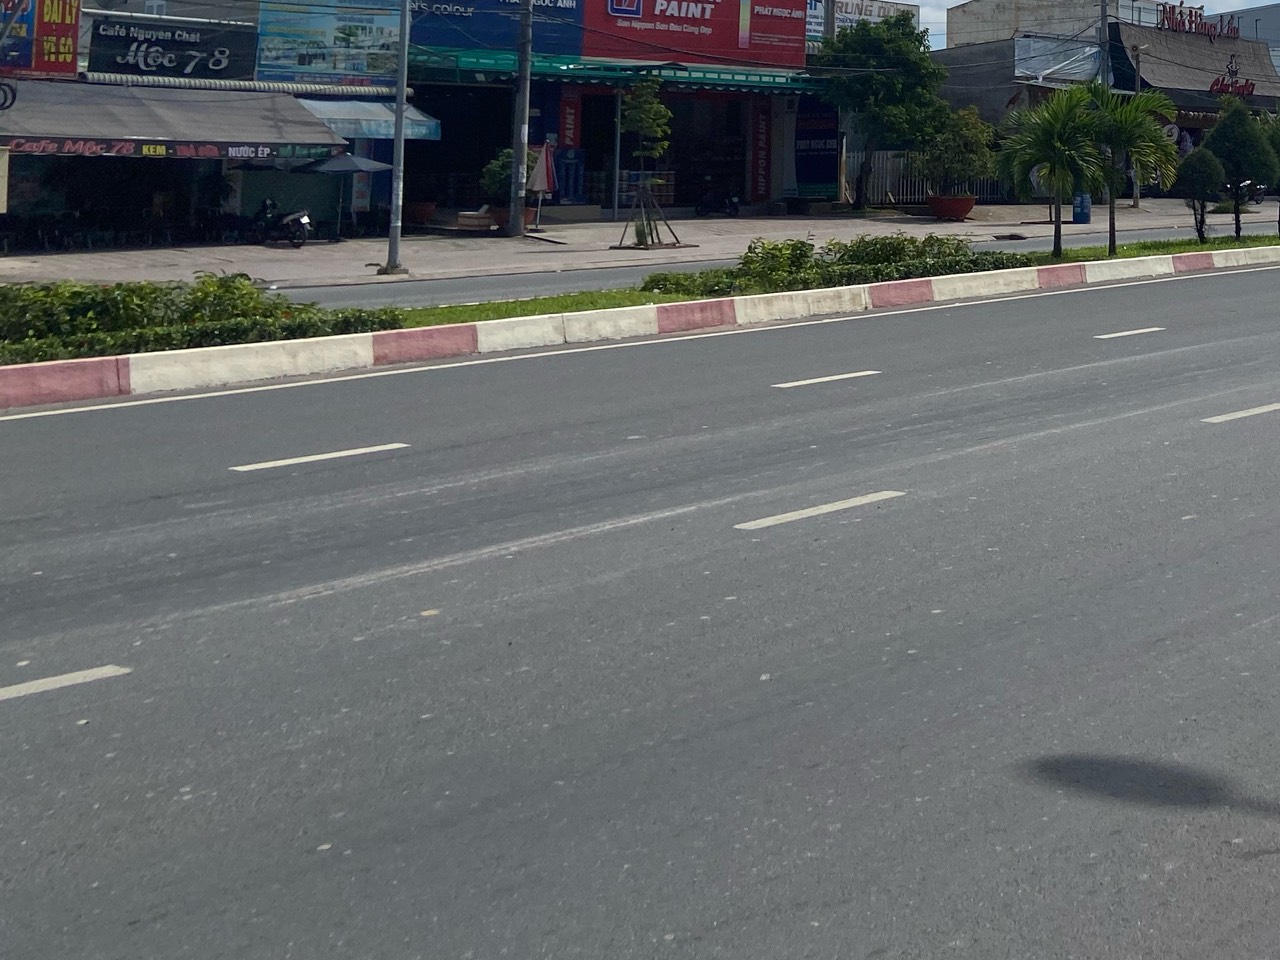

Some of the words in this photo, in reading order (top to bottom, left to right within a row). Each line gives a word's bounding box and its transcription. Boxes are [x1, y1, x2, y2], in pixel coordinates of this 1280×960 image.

[432, 3, 475, 17] colour
[654, 0, 715, 20] PAINT
[565, 108, 575, 145] PAINT
[110, 142, 136, 154] 78
[142, 145, 166, 155] KEM
[257, 145, 271, 157] ÉP
